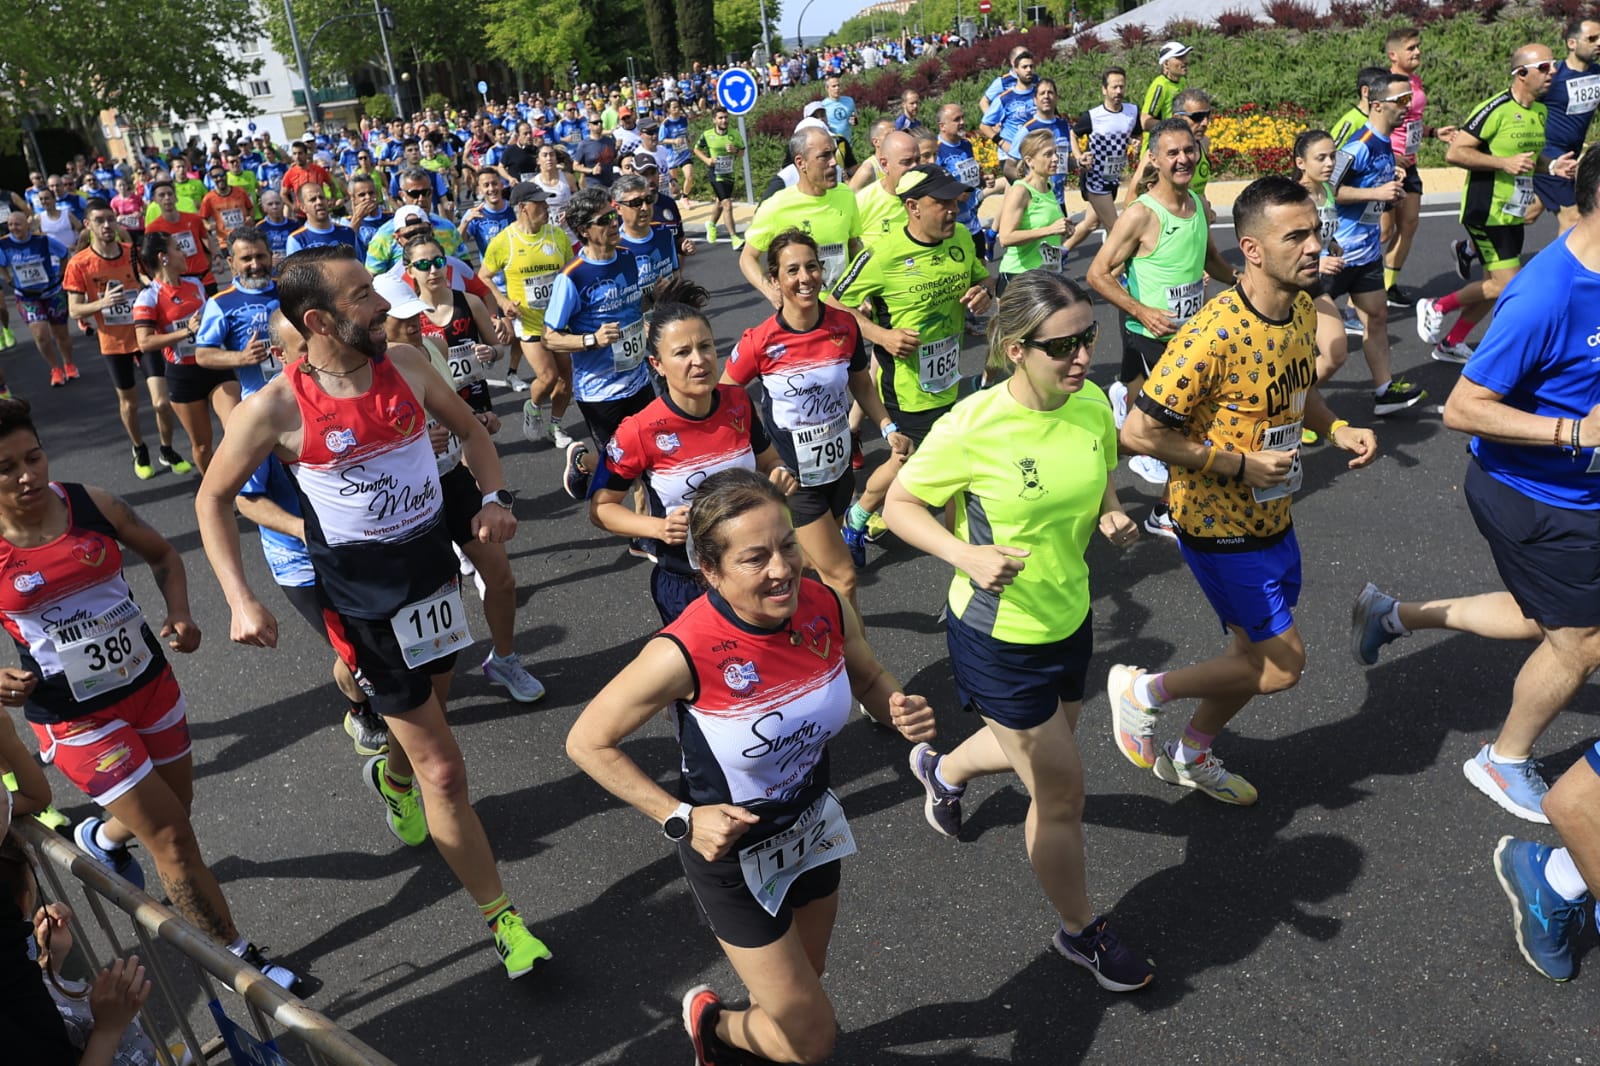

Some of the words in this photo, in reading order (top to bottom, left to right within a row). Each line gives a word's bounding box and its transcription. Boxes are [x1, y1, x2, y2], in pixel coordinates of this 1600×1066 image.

[1574, 87, 1600, 104] 1828
[962, 165, 979, 181] 1452
[519, 263, 561, 275] VILLORUELA
[1170, 287, 1182, 298] XII
[251, 311, 268, 324] XII
[622, 333, 643, 357] 961
[449, 359, 472, 378] 20
[927, 349, 957, 379] 1652
[797, 430, 812, 444] XII
[1269, 430, 1285, 446] XII
[811, 436, 844, 467] 798
[339, 464, 399, 497] Simón
[368, 475, 437, 521] Martín
[409, 600, 452, 639] 110
[57, 624, 83, 645] XII
[82, 619, 99, 630] SAN
[84, 627, 132, 671] 386
[742, 711, 822, 759] Simón
